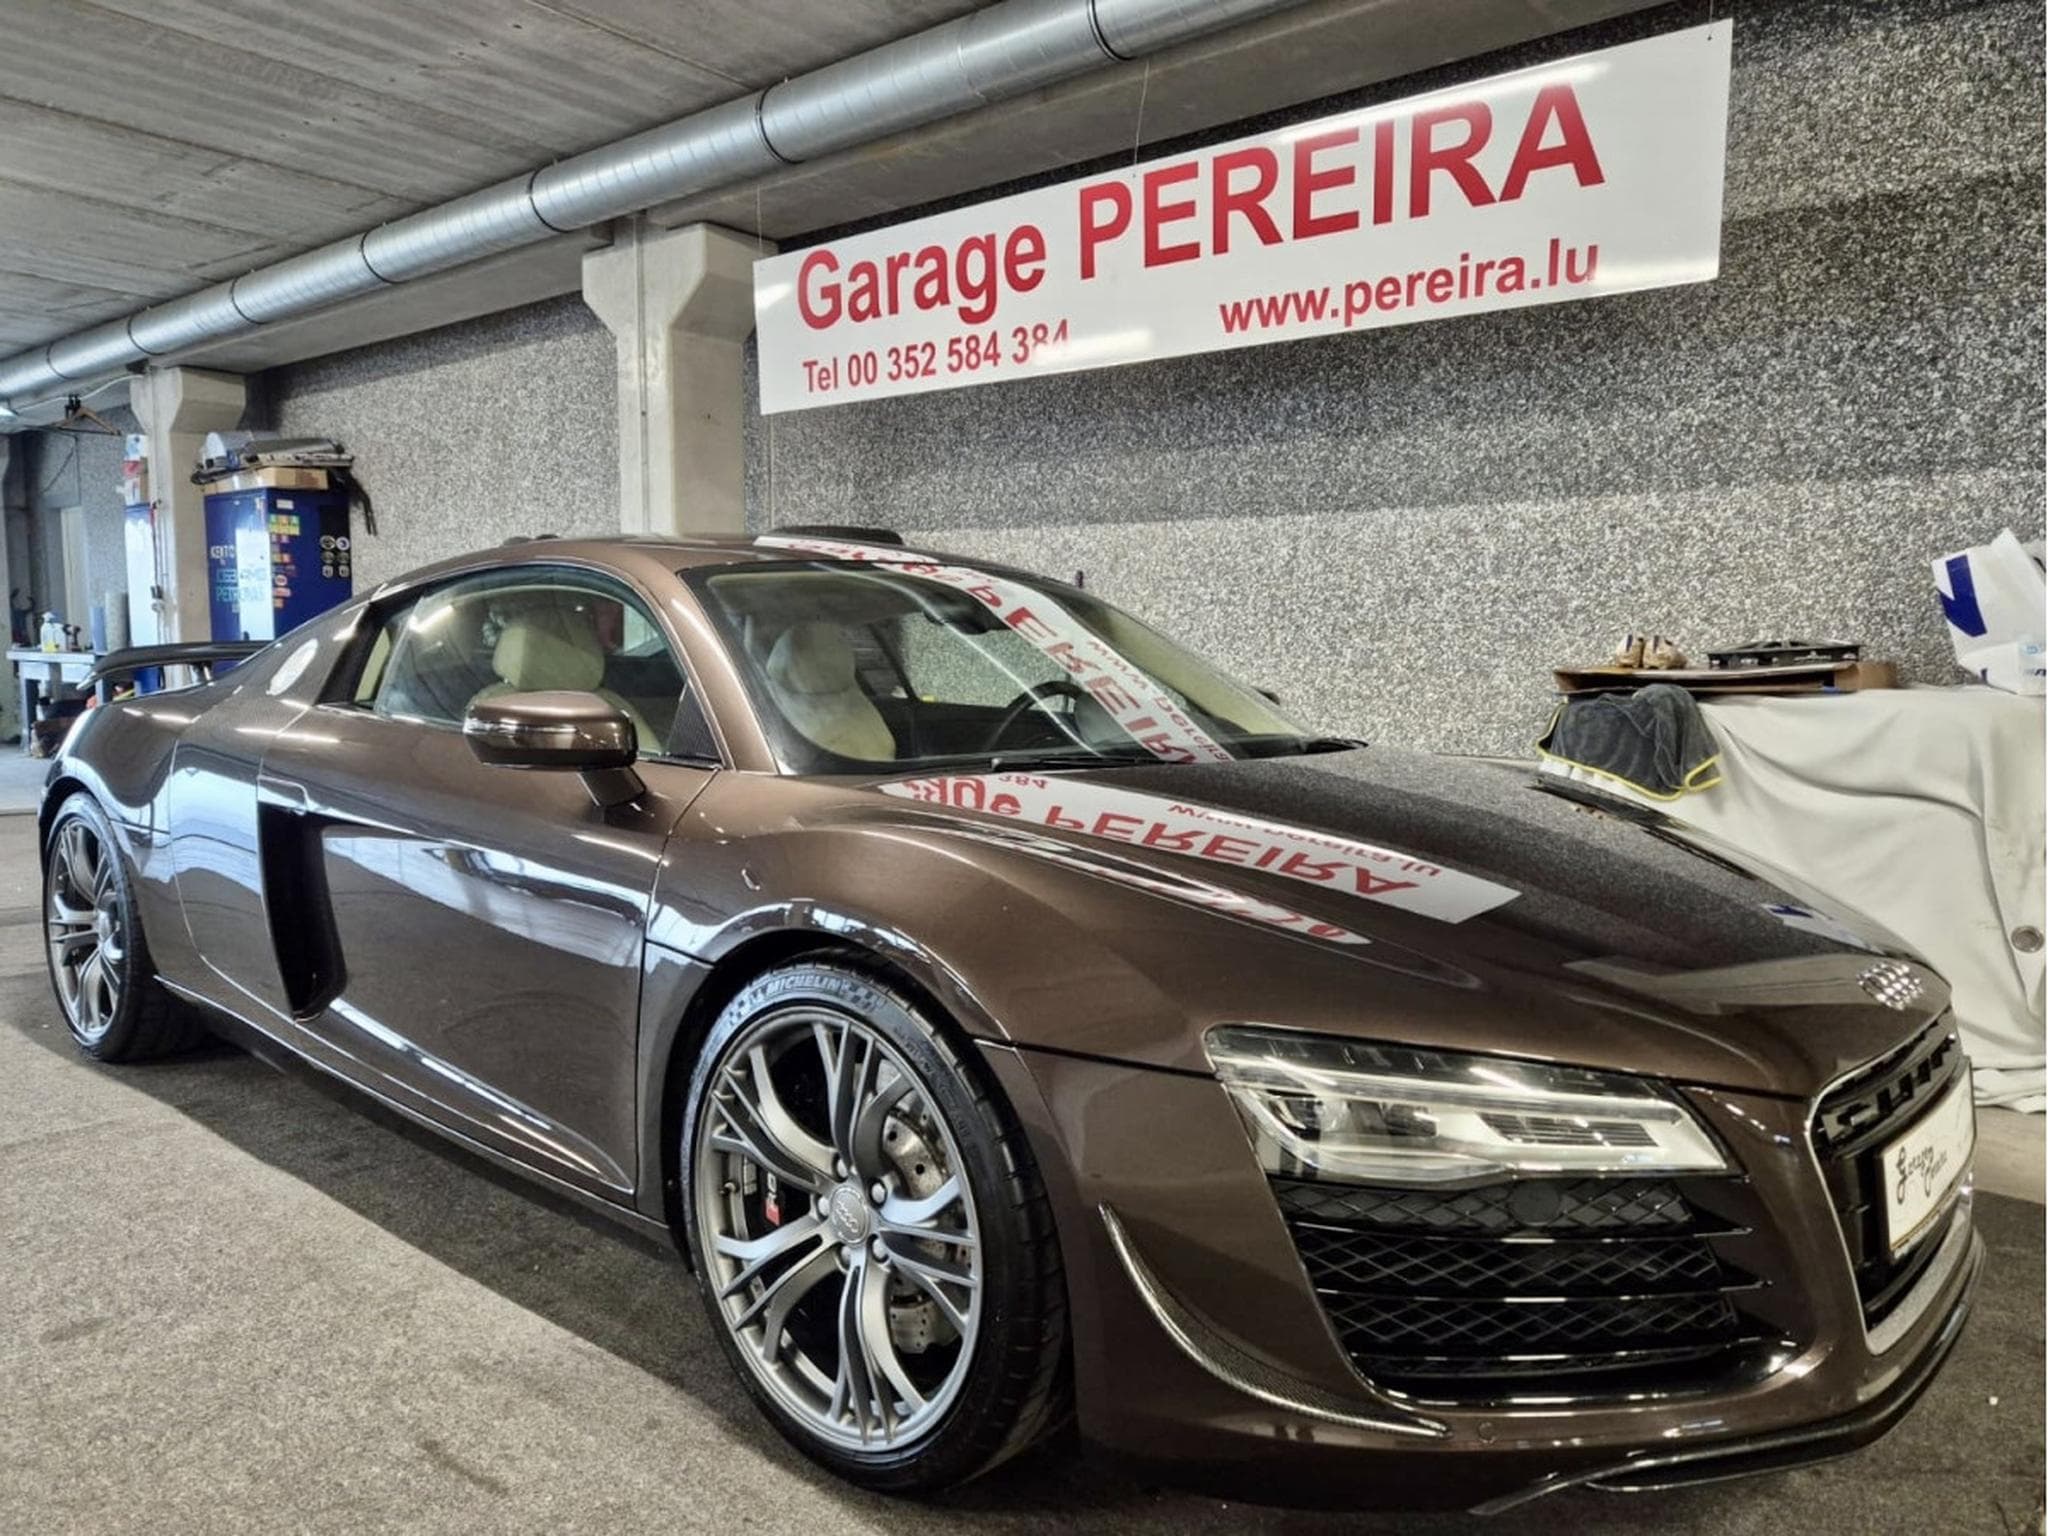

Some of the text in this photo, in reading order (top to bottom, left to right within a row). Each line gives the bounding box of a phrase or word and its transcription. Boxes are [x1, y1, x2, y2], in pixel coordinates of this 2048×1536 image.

[798, 80, 1606, 330] Garage PEREIRA
[1219, 238, 1599, 333] www.pereira.lu
[803, 357, 838, 392] Tel
[848, 351, 877, 386] 00
[887, 341, 937, 381] 352
[947, 331, 1001, 373] 584
[766, 974, 842, 994] MICHELIN
